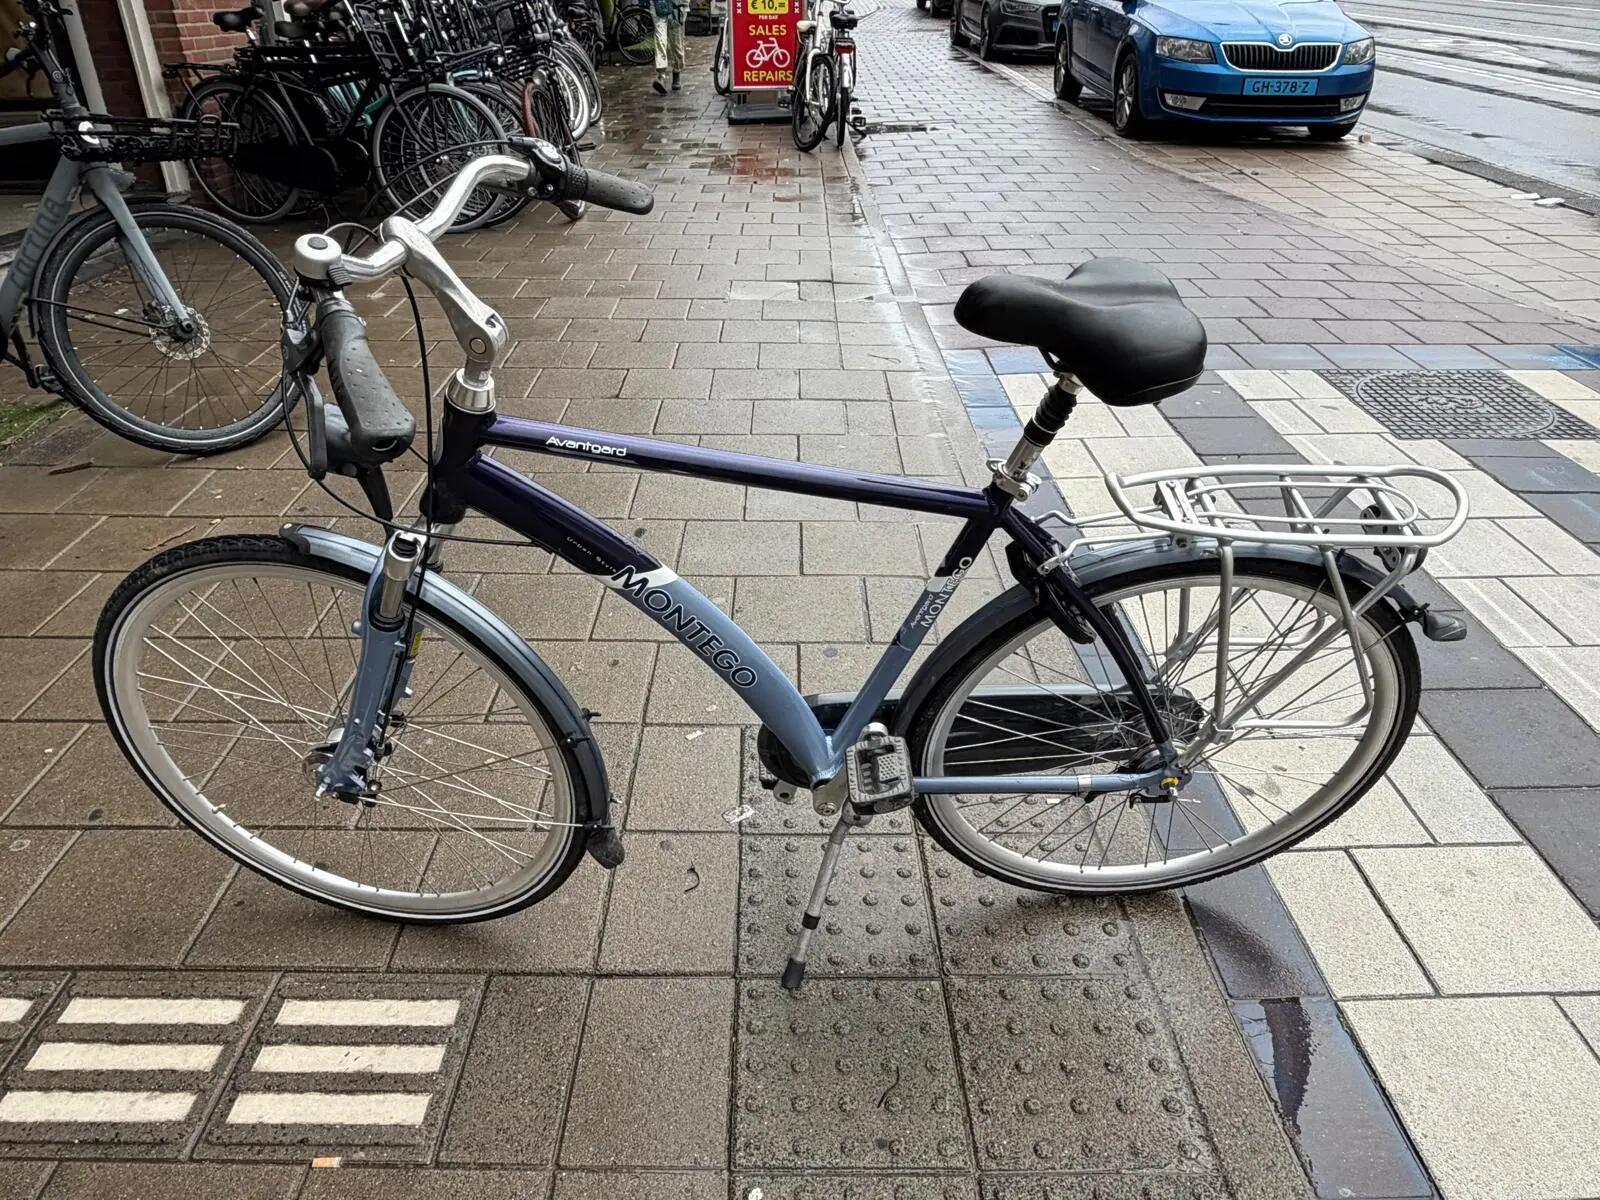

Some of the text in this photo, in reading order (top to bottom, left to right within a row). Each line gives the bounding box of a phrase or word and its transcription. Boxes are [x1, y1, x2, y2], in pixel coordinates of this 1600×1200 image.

[748, 25, 787, 36] SALES
[743, 70, 793, 82] REPAIRS
[1252, 81, 1310, 94] GH-378-Z
[545, 435, 627, 457] Avantgard
[920, 556, 973, 628] MONTEGO
[610, 565, 758, 688] MONTEGO
